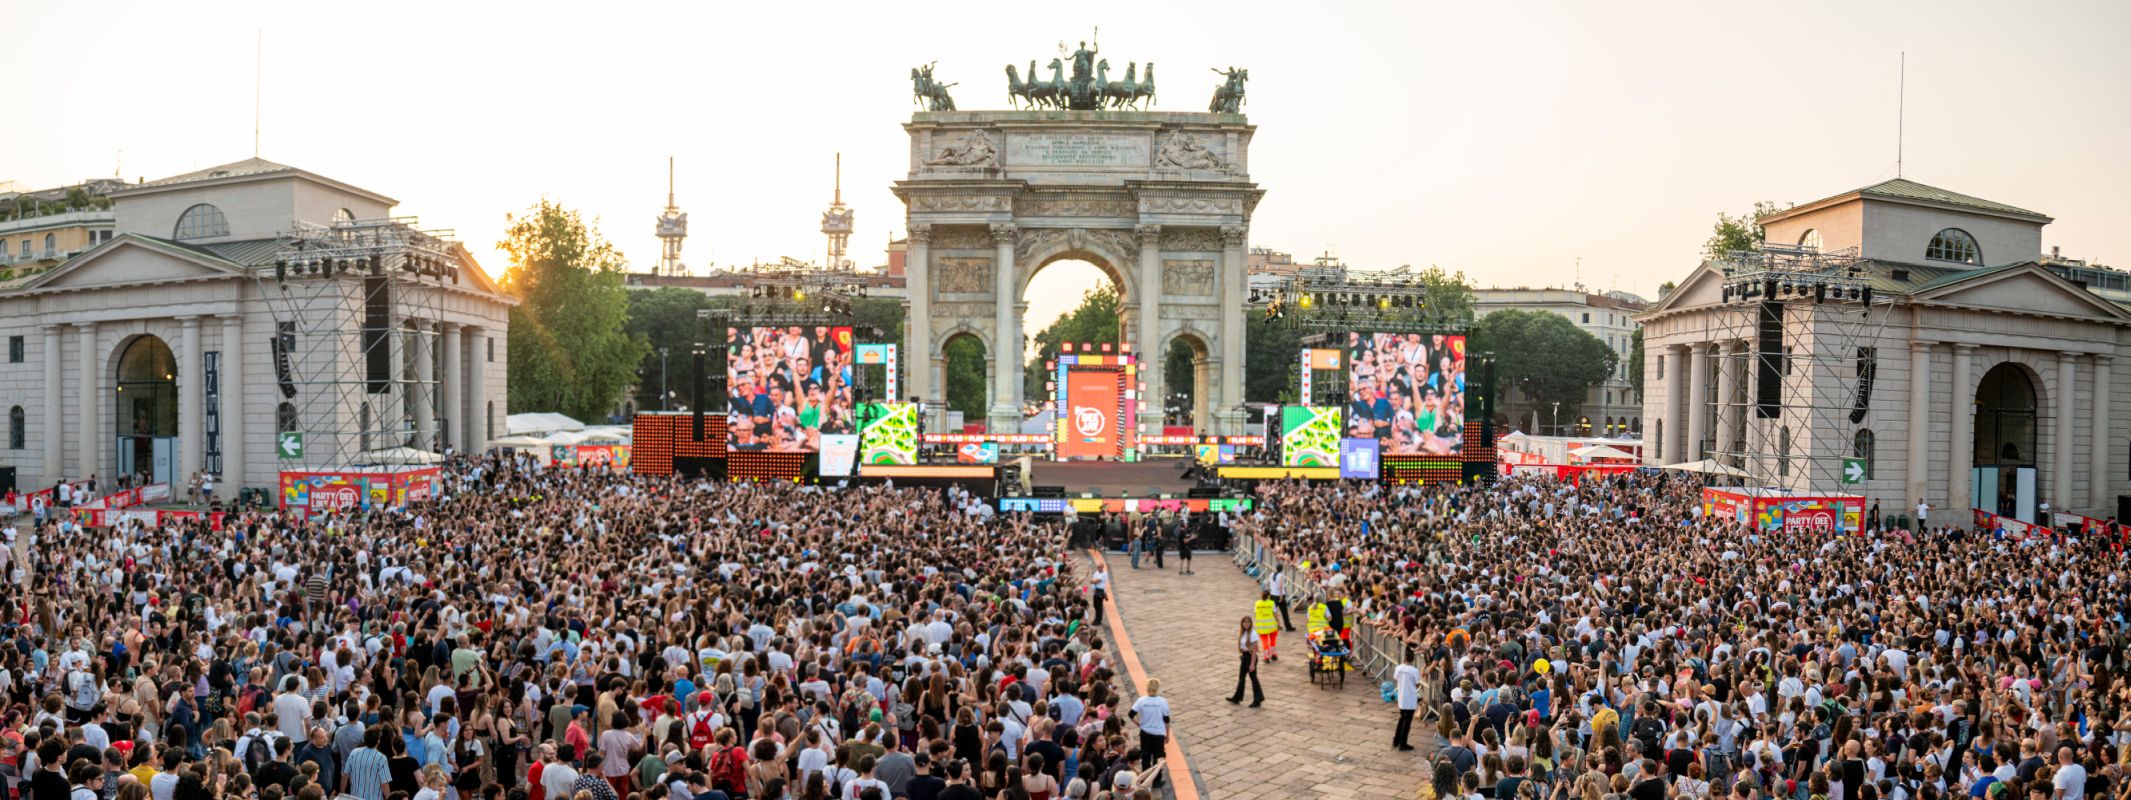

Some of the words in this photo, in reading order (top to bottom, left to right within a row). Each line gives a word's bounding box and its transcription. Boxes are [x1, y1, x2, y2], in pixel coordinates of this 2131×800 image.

[311, 491, 336, 500] PARTY
[340, 492, 354, 500] DEE
[1786, 517, 1811, 525] PARTY
[1815, 516, 1829, 525] DEE
